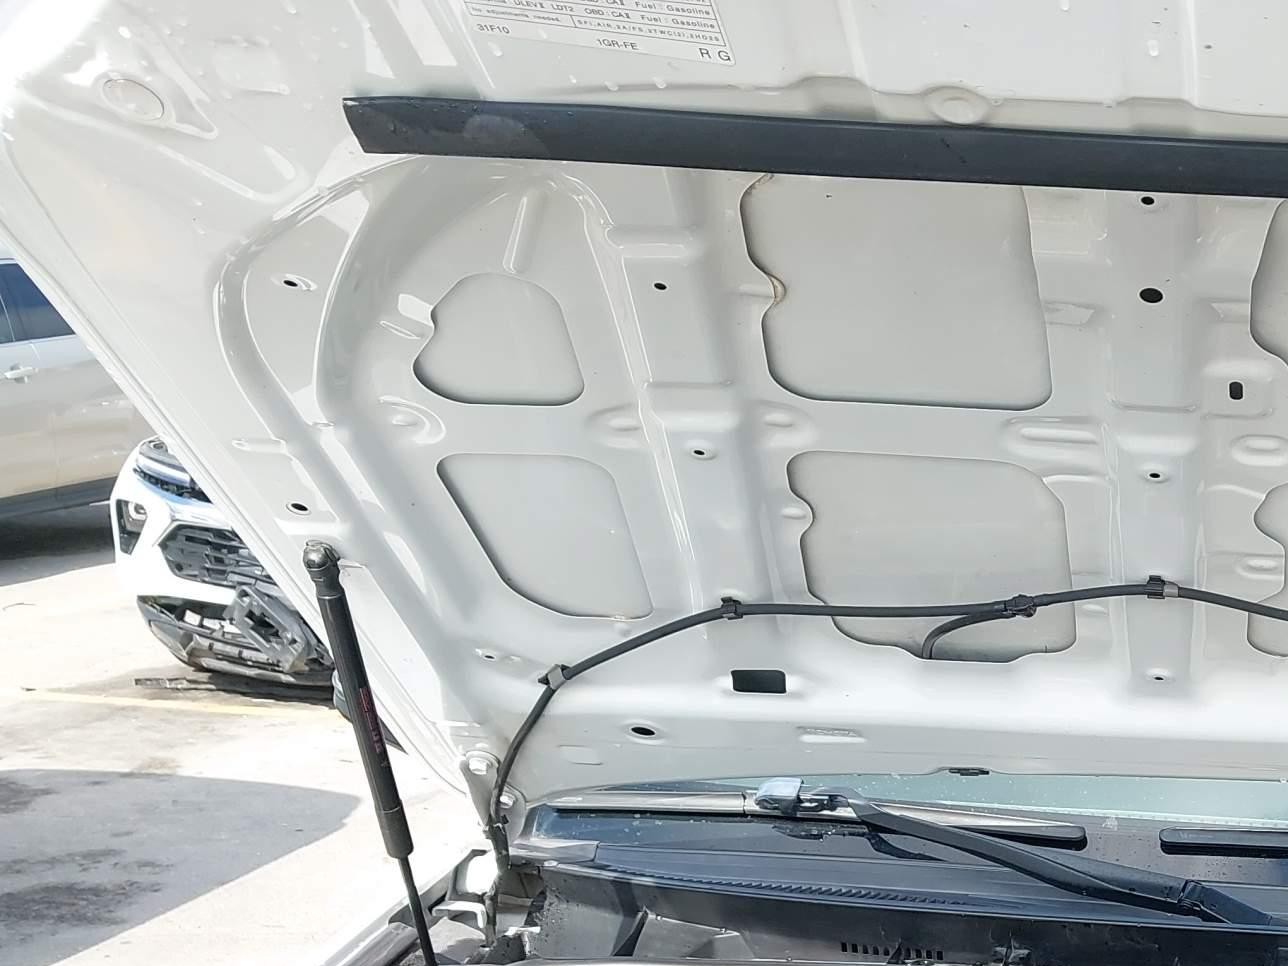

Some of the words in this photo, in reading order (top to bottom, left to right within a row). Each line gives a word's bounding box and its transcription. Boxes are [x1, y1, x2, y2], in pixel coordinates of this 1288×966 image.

[640, 14, 662, 24] Fuel
[672, 18, 716, 29] Gasoline
[596, 38, 639, 50] 1GR-FE
[698, 47, 712, 60] R
[718, 50, 732, 62] G
